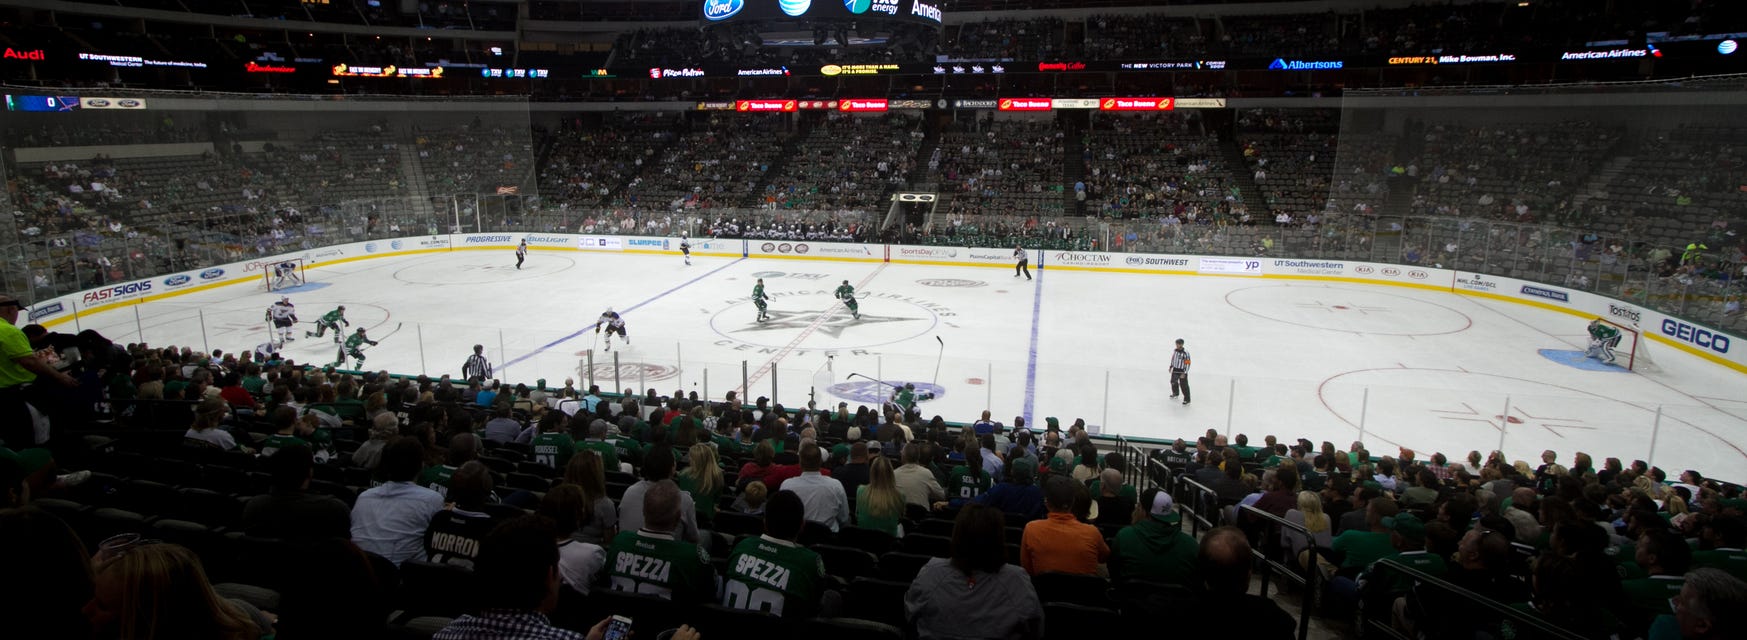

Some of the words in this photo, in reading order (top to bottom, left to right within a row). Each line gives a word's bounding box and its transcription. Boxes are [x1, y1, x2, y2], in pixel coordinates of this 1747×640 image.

[709, 0, 732, 15] Ford
[872, 4, 898, 14] energy
[3, 48, 45, 60] Audi
[90, 54, 142, 62] SOUTHWESTERN
[1460, 55, 1499, 63] Bowman,
[1562, 51, 1608, 60] American
[1608, 49, 1646, 58] Airlines
[245, 62, 295, 73] Budweiser
[1288, 60, 1343, 69] Albertsons
[47, 97, 55, 107] 0
[465, 235, 512, 243] PROGRESSIVE
[1061, 251, 1112, 262] CHOCTAW
[1145, 258, 1188, 266] SOUTHWEST
[1245, 260, 1260, 270] yp
[1285, 261, 1344, 269] Southwestern
[83, 280, 152, 303] FASTSIGNS
[1661, 318, 1730, 354] GEICO
[714, 339, 869, 357] CENTER
[615, 551, 671, 583] SPEZZA
[735, 553, 791, 590] SPEZZA
